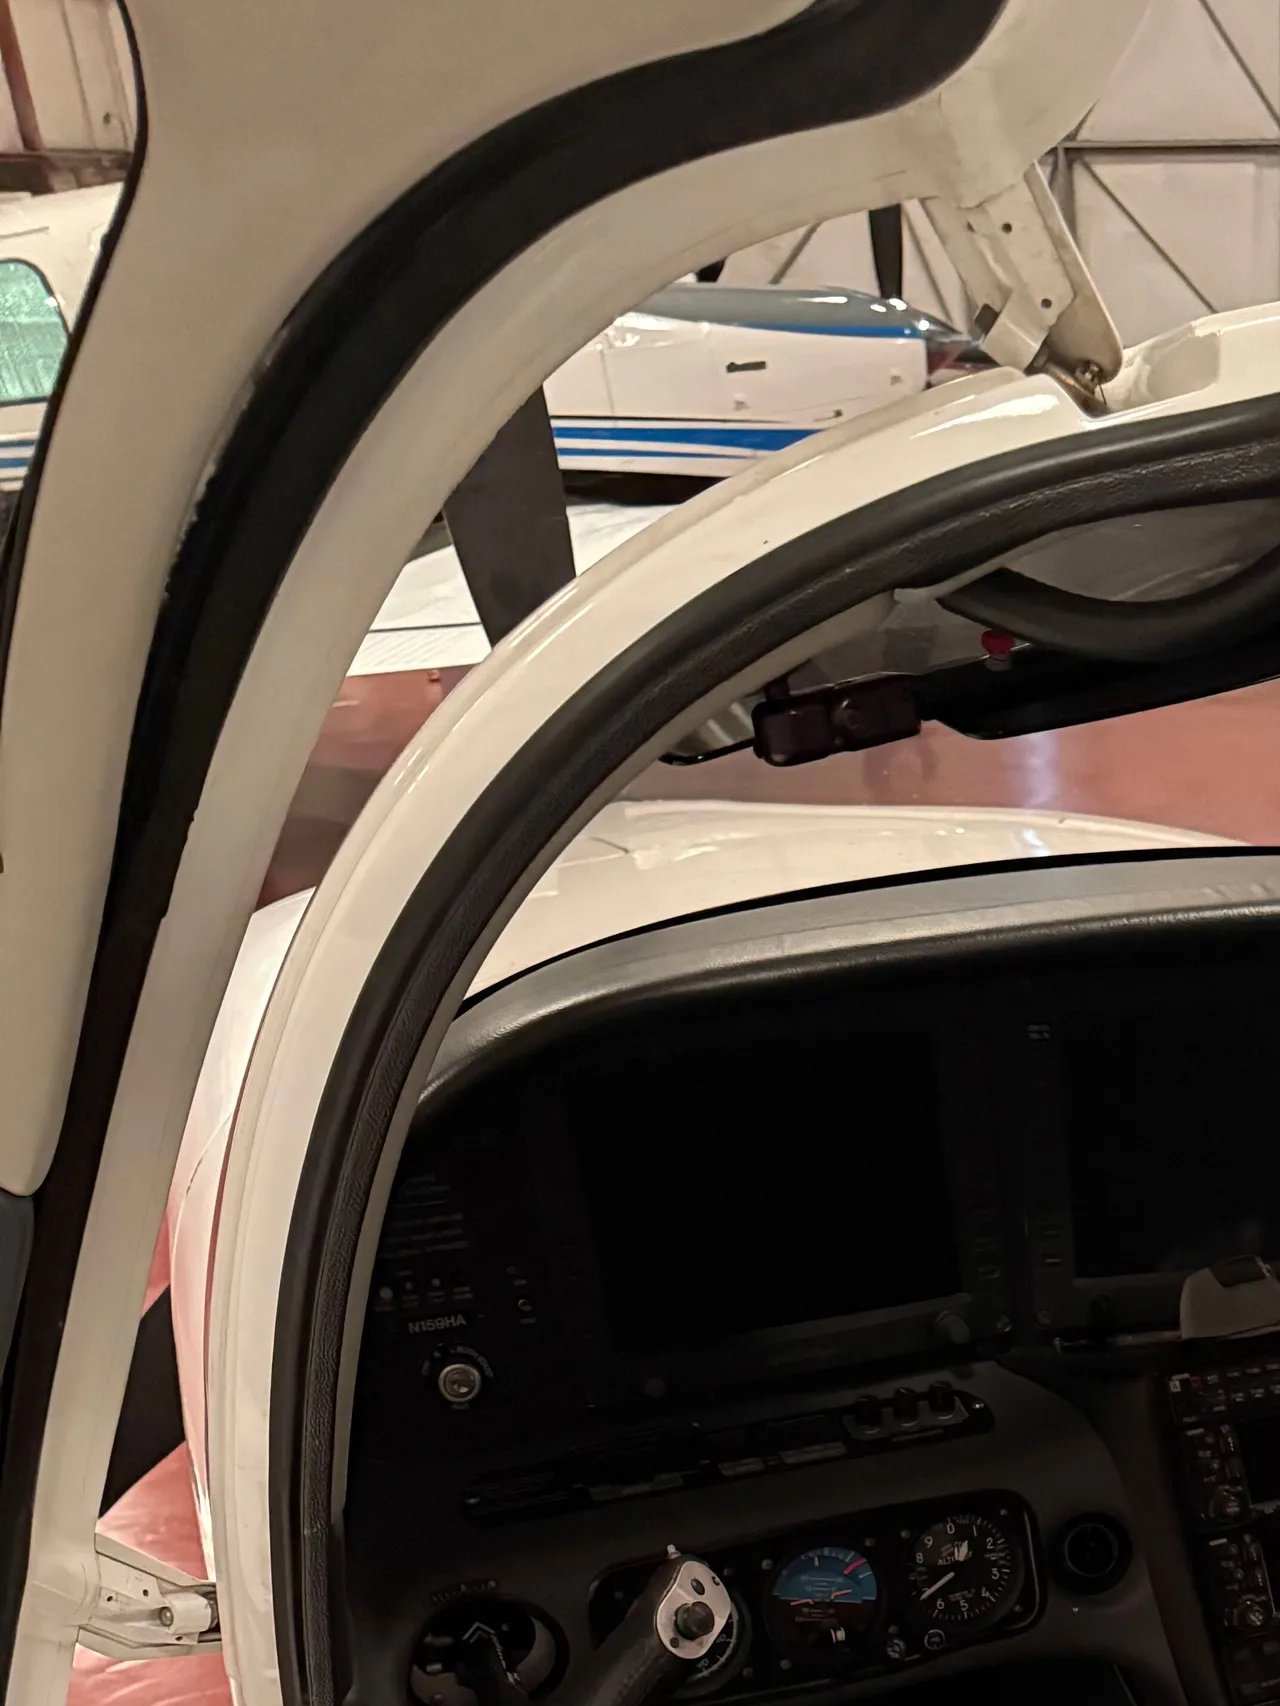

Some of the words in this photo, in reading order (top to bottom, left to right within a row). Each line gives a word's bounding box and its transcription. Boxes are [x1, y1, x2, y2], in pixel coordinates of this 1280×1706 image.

[946, 1523, 955, 1534] 0
[924, 1536, 933, 1548] 9
[986, 1537, 995, 1549] 2
[916, 1552, 923, 1563] 8
[936, 1598, 945, 1610] 6
[960, 1600, 968, 1611] 5
